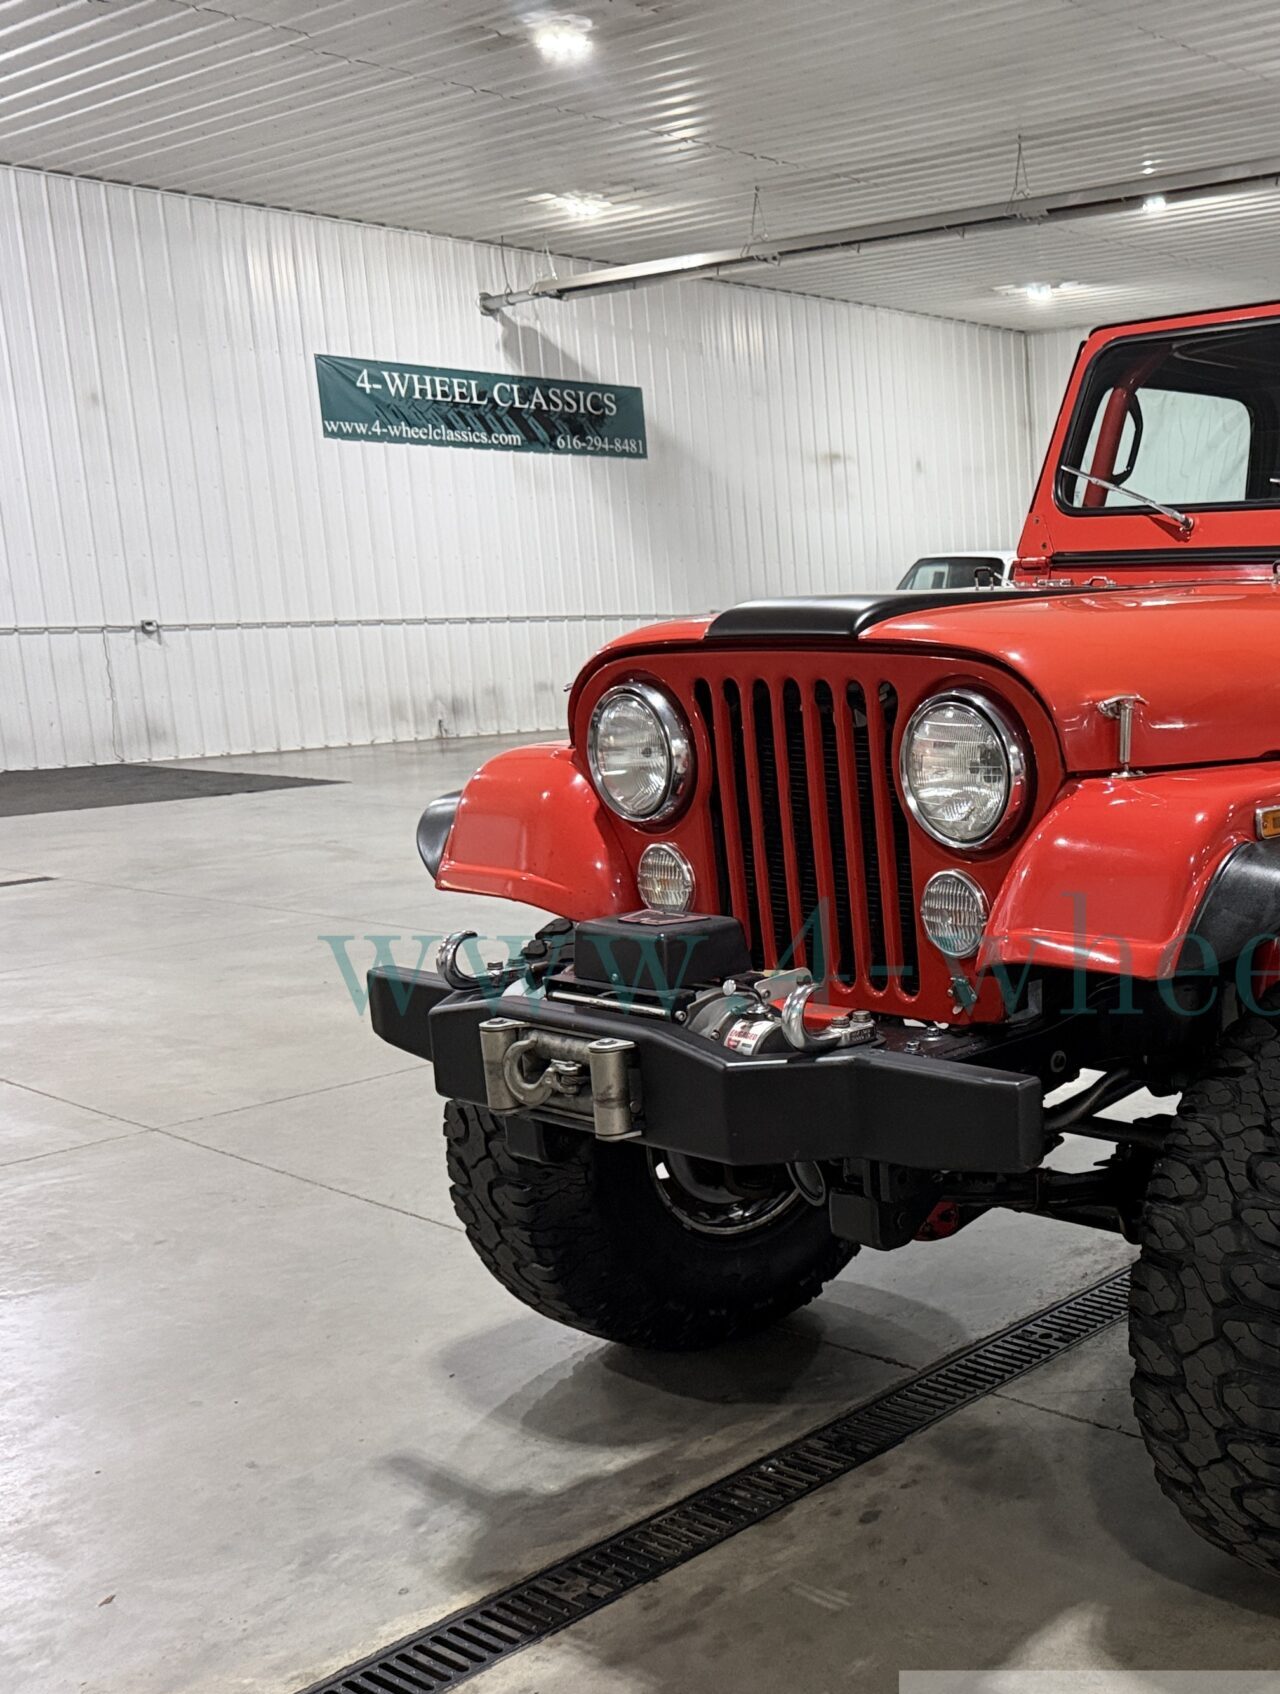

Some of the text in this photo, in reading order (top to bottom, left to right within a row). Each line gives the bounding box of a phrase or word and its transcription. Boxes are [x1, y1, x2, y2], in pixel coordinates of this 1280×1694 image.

[356, 368, 617, 416] 4-WHEEL CLASSICS
[324, 419, 522, 447] www.4-wheelclassics.com
[556, 433, 645, 455] 616-294-8481
